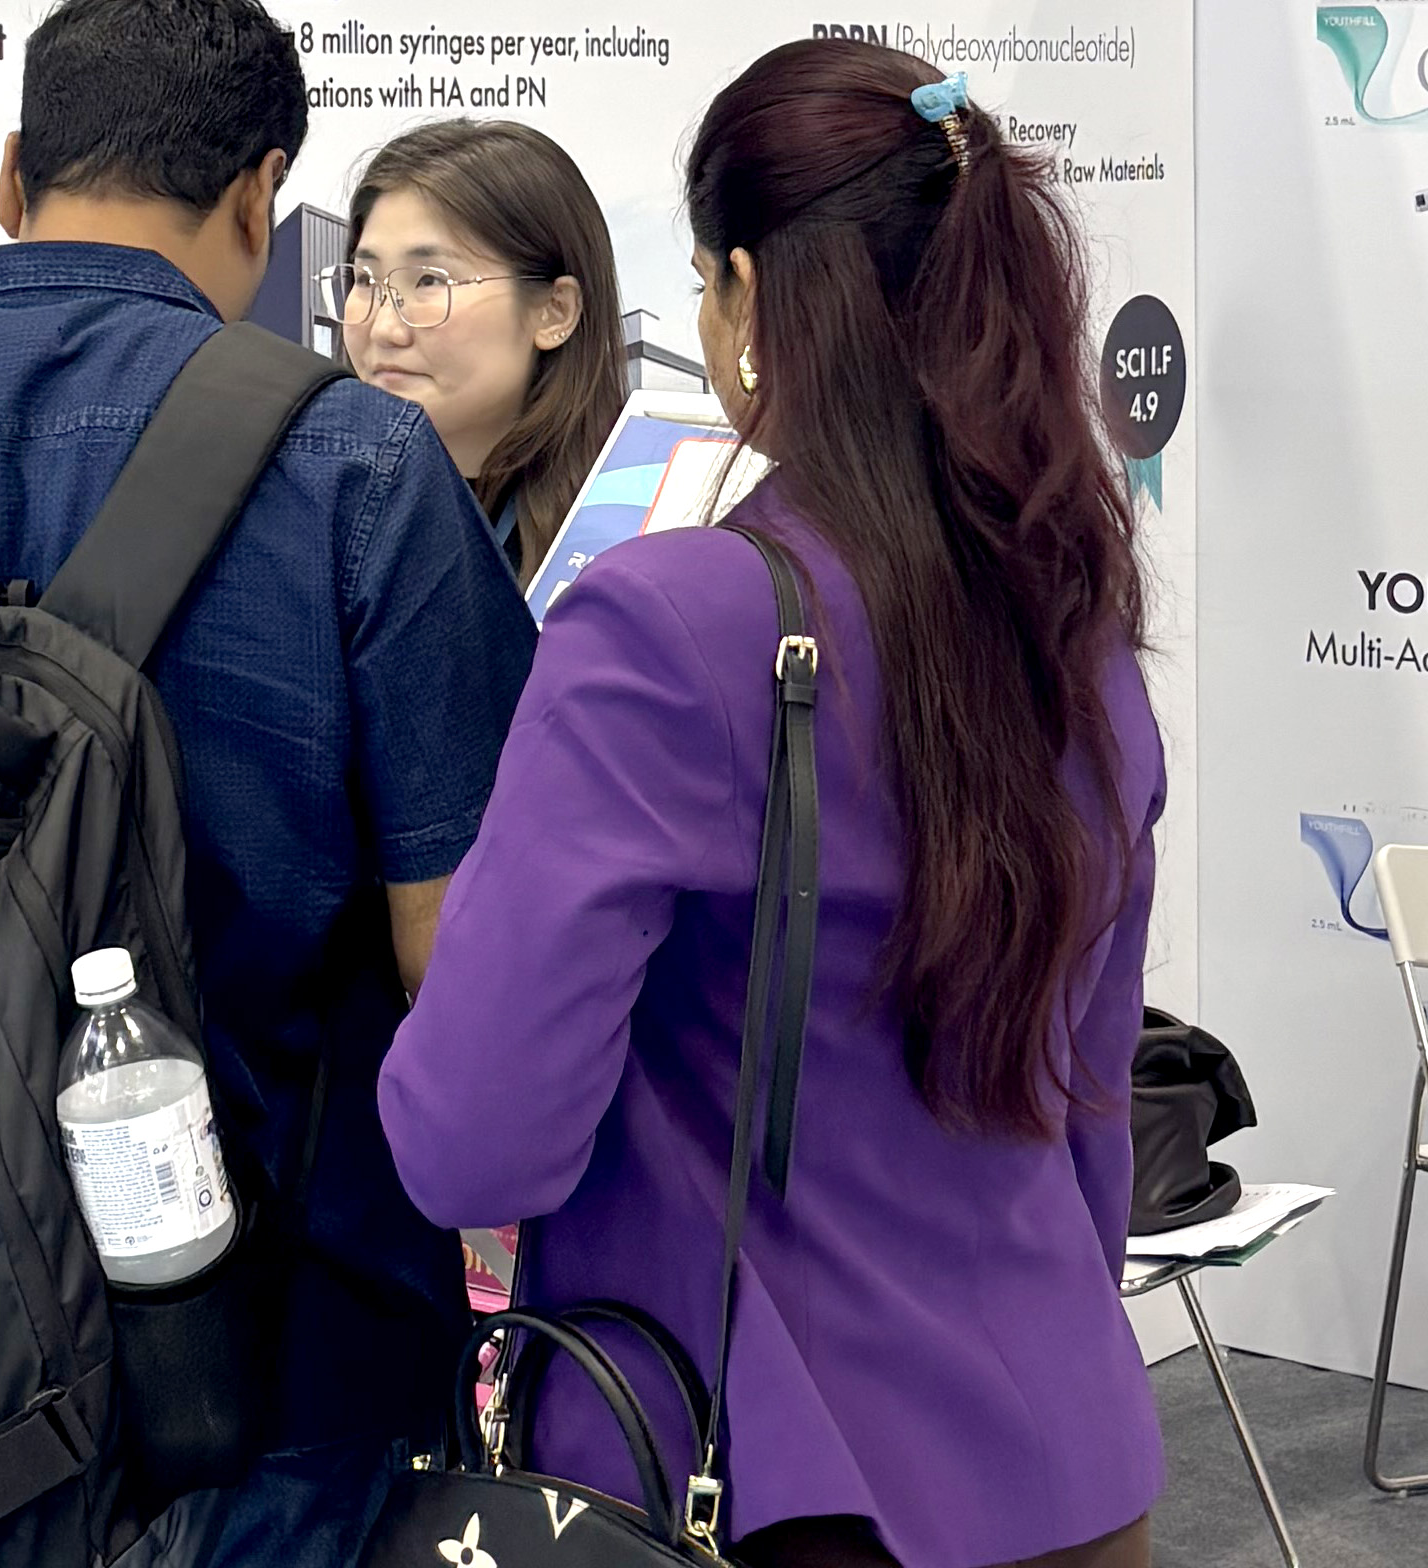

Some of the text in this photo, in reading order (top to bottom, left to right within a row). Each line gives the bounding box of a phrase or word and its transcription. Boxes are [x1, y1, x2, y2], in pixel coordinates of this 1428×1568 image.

[1323, 15, 1378, 28] YOUTHFILL
[300, 19, 671, 66] 8 million syringes per year, including
[378, 74, 547, 108] with HA and PN
[1010, 116, 1078, 148] Recovery
[1063, 153, 1165, 184] Raw Materials
[1116, 349, 1146, 379] SCI
[1129, 392, 1159, 422] 4.9
